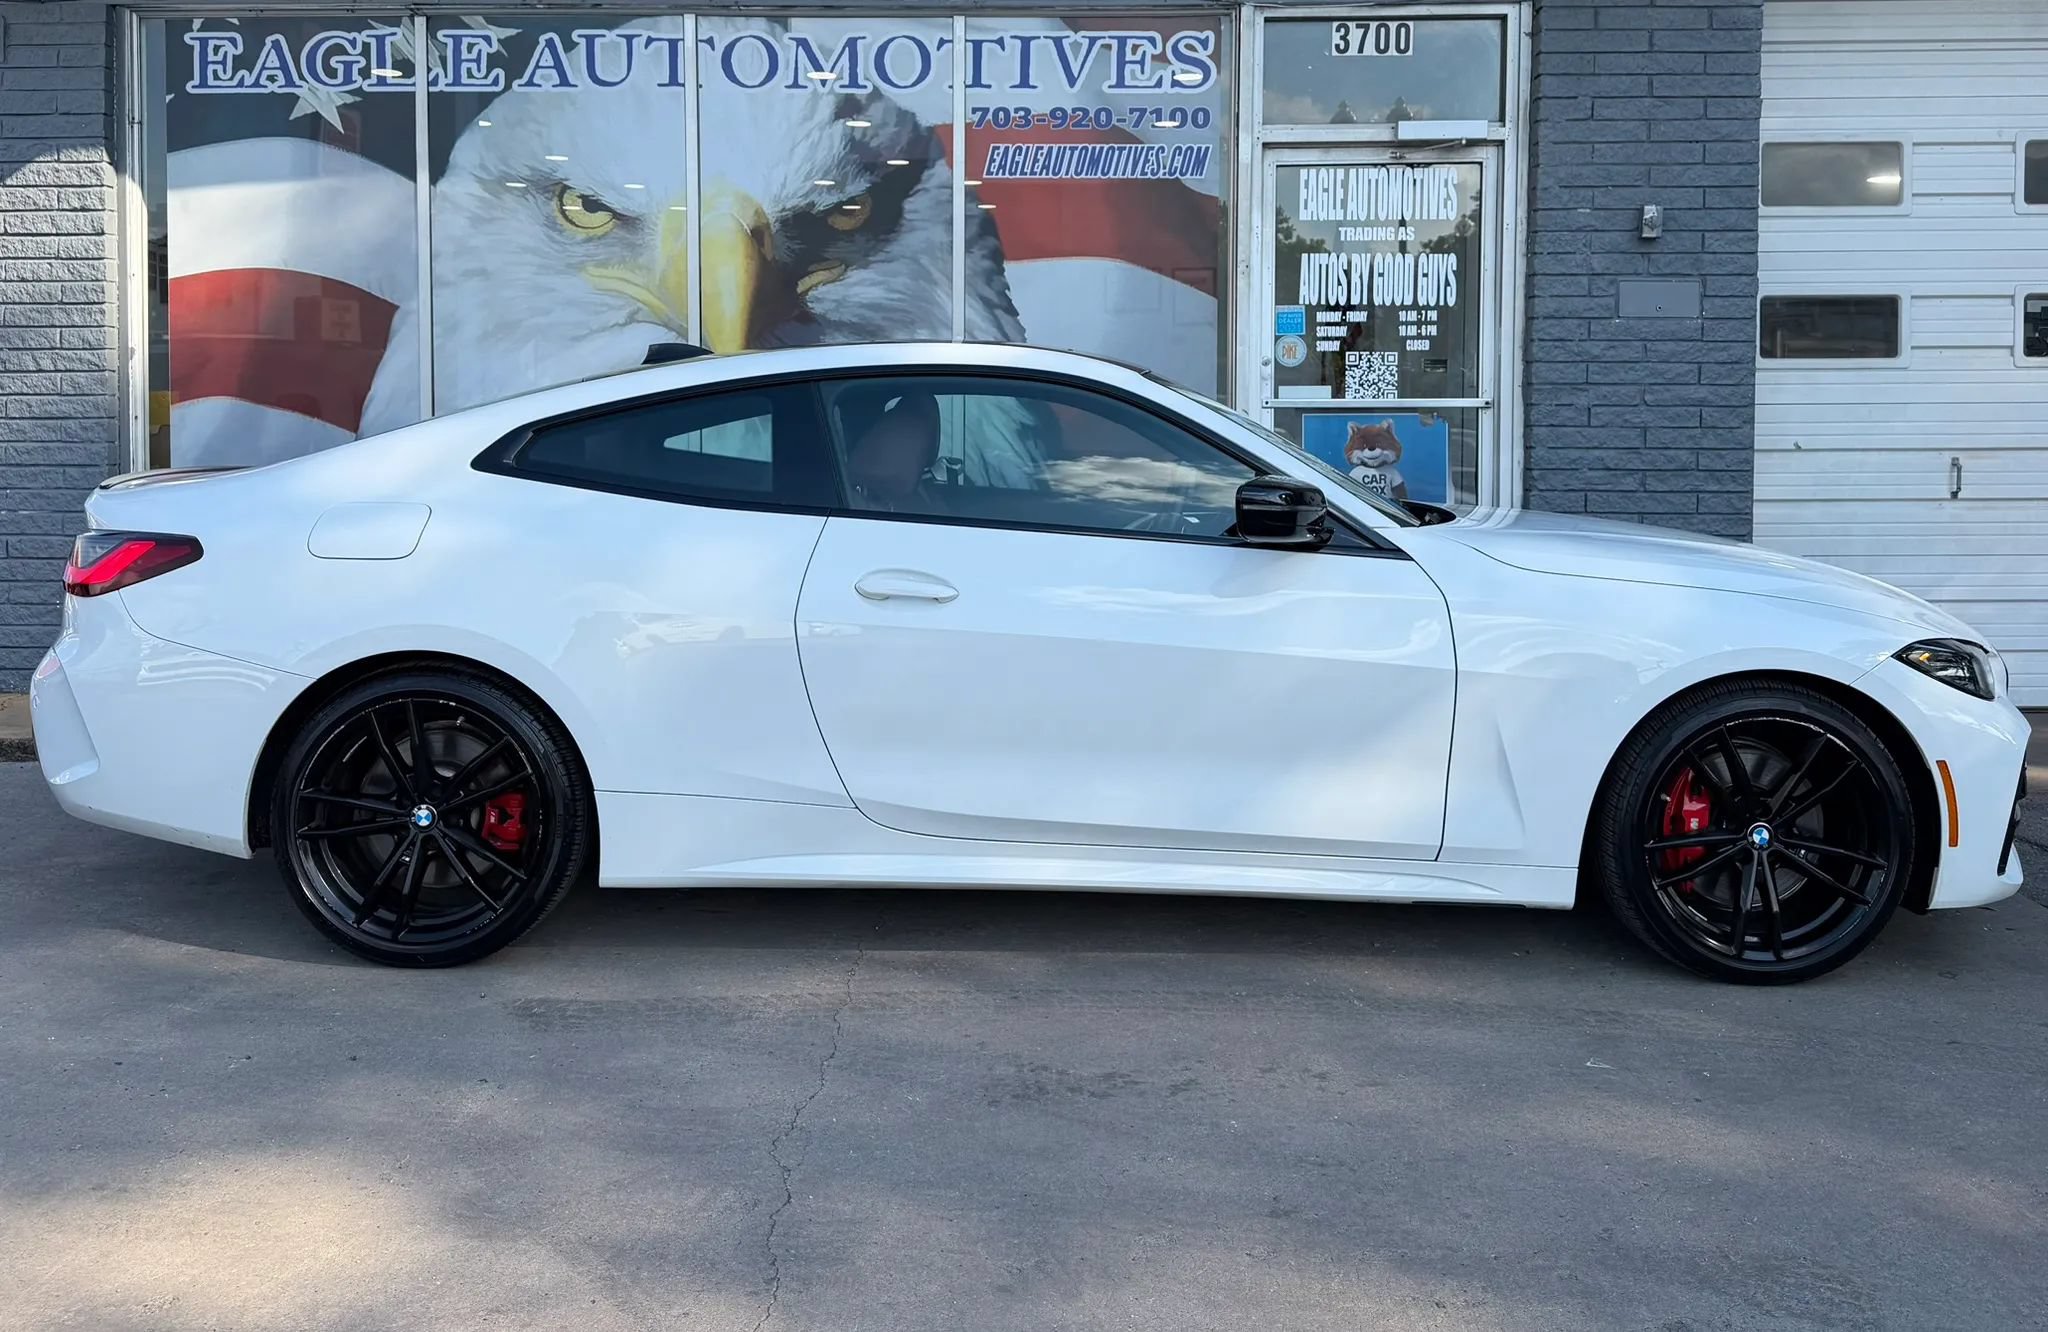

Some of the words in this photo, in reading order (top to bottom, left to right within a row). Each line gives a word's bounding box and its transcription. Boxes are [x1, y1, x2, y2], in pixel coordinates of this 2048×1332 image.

[1334, 22, 1411, 54] 3700
[185, 29, 504, 92] EAGLE
[513, 29, 1217, 93] AUTOMOTIVES
[971, 105, 1212, 130] 703-920-7100
[983, 143, 1213, 179] EAGLEAUTOMOTIVES.COM
[1299, 167, 1345, 221] EAGLE
[1346, 167, 1458, 221] AUTOMOTIVES
[1339, 227, 1396, 241] TRADING
[1398, 227, 1415, 241] AS
[1299, 252, 1348, 306] AUTOS
[1350, 252, 1372, 305] BY
[1373, 252, 1415, 306] GOOD
[1417, 252, 1458, 307] GUYS
[1316, 311, 1342, 322] MONDAY
[1346, 311, 1368, 322] FRIDAY
[1316, 326, 1348, 337] SATURDAY
[1316, 340, 1341, 351] SUNDAY
[1406, 340, 1430, 351] CLOSED
[1362, 474, 1387, 485] CAR
[1367, 485, 1387, 496] OX
